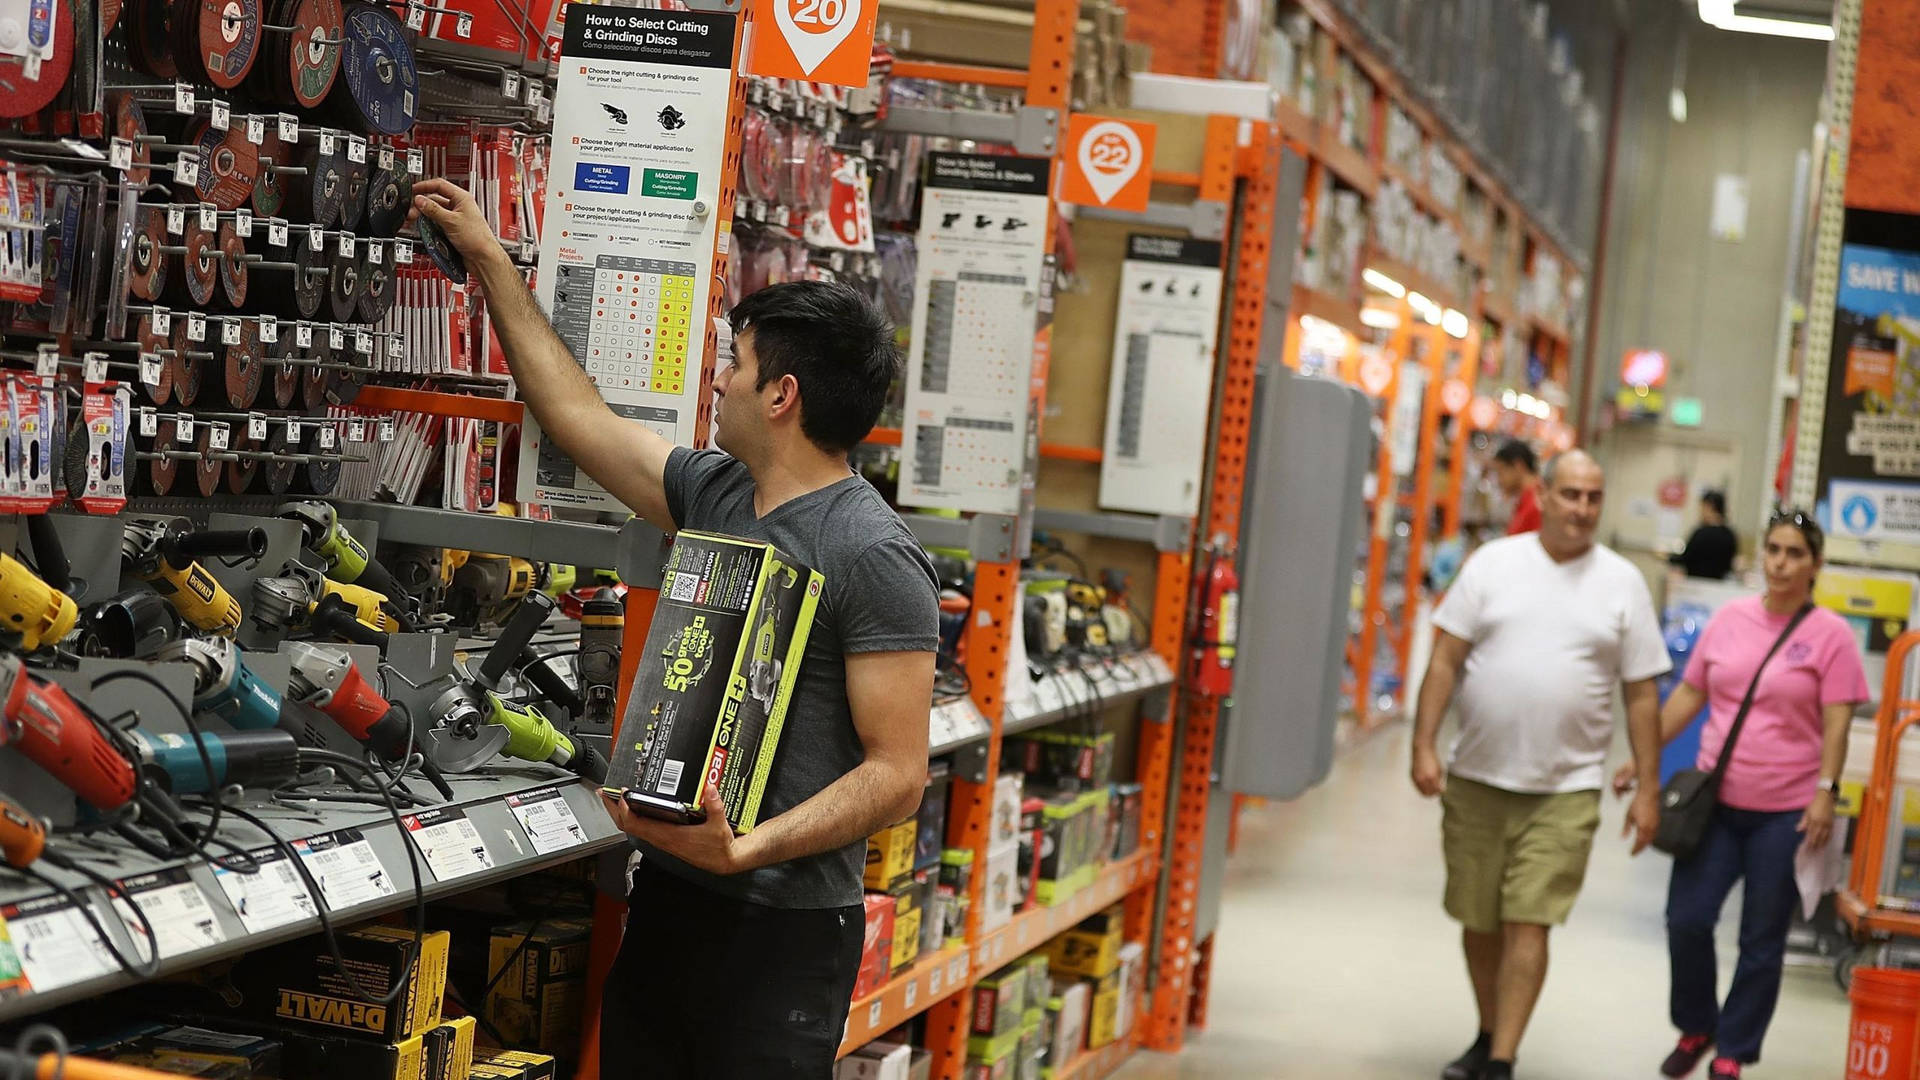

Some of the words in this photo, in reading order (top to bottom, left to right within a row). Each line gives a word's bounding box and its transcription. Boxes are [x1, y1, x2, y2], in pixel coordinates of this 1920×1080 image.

[793, 0, 844, 26] 20
[585, 14, 612, 26] How
[615, 16, 626, 27] to
[628, 17, 664, 30] Select
[667, 20, 709, 36] Cutting
[583, 28, 593, 40] &
[595, 29, 643, 46] Grinding
[646, 33, 678, 46] Discs
[640, 45, 662, 54] discos
[663, 48, 678, 56] para
[678, 48, 711, 58] desgastar
[588, 67, 610, 75] Choose
[621, 70, 635, 78] right
[636, 72, 656, 80] cutting
[662, 74, 686, 82] grinding
[580, 137, 603, 145] Choose
[614, 140, 628, 148] right
[628, 142, 652, 150] material
[652, 144, 685, 153] application
[1093, 144, 1128, 167] 22
[592, 167, 613, 175] METAL
[655, 172, 687, 181] MASONRY
[572, 212, 585, 220] your
[586, 213, 640, 224] project/application
[573, 204, 595, 212] Choose
[606, 207, 621, 215] right
[621, 208, 642, 217] cutting
[648, 211, 673, 219] grinding
[558, 253, 584, 261] Projects
[1847, 262, 1898, 293] SAVE
[702, 551, 715, 581] NATION
[678, 625, 693, 658] great
[694, 629, 710, 658] tools
[663, 664, 673, 687] over
[667, 657, 694, 693] 50
[724, 751, 734, 777] ANGLE
[730, 719, 743, 750] GRINDER
[276, 991, 386, 1030] DEWALT
[1850, 1040, 1889, 1077] DO
